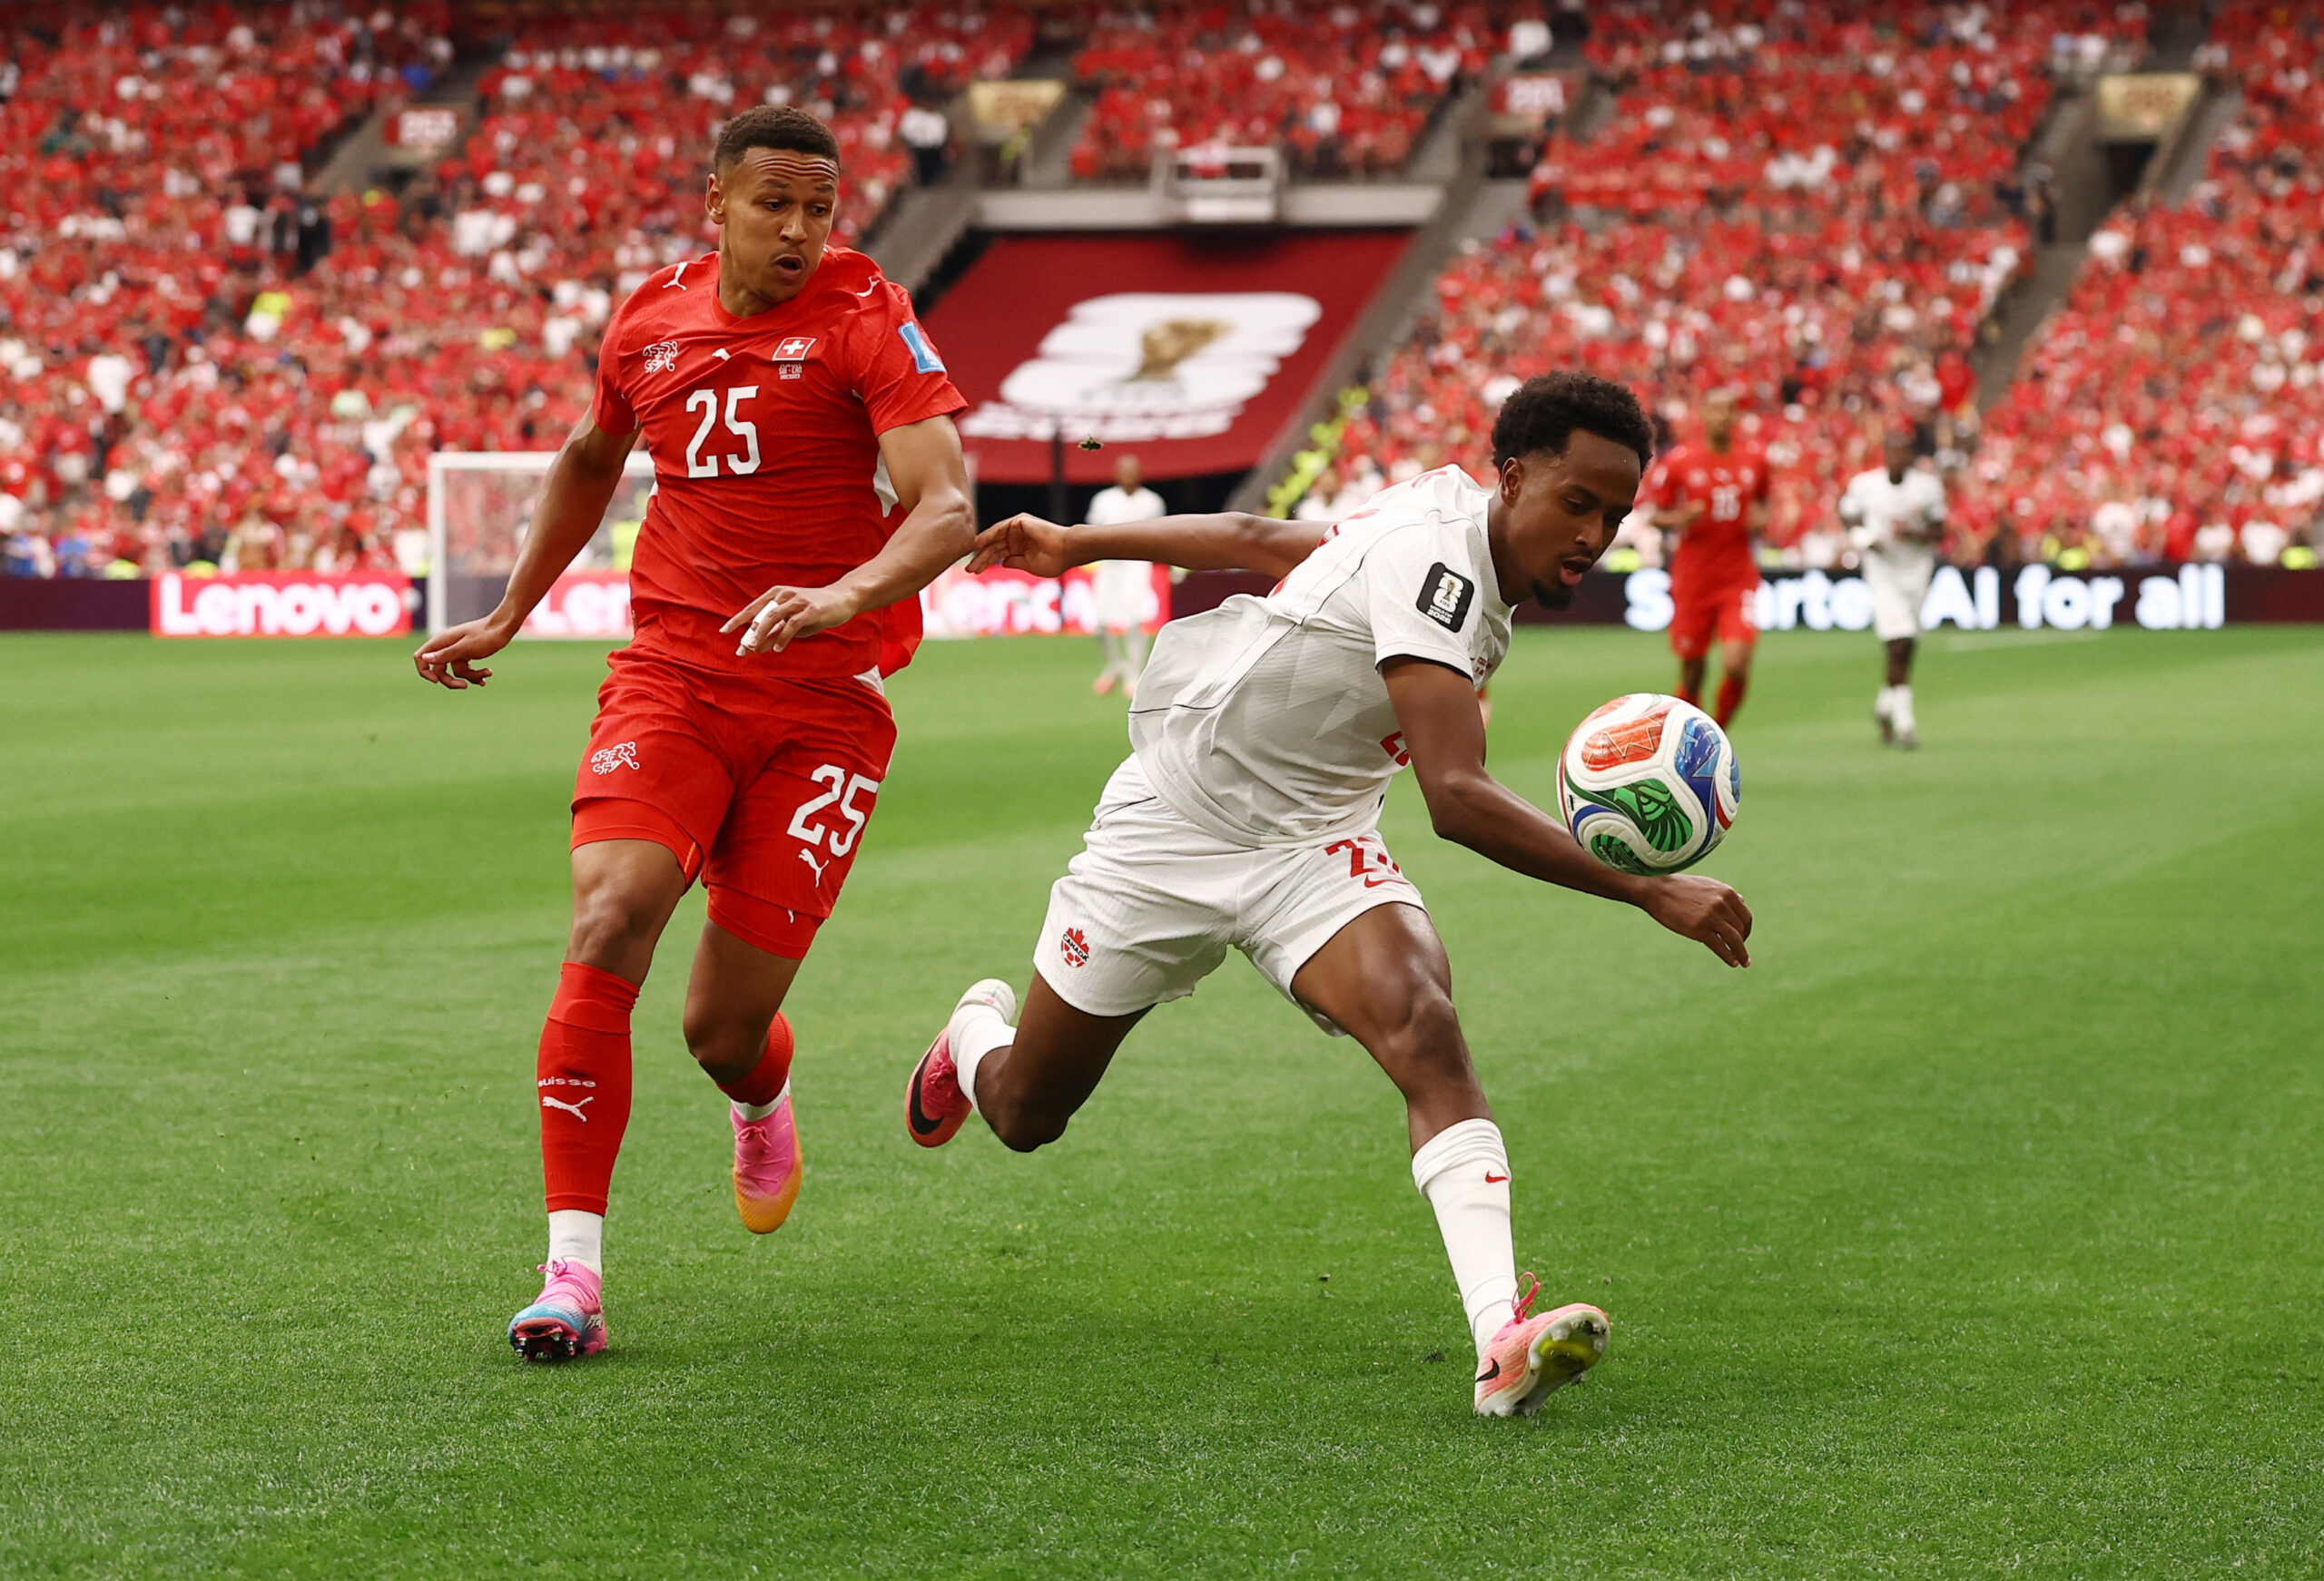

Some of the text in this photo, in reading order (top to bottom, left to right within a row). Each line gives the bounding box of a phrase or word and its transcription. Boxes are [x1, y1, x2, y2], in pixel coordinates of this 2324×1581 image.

[685, 386, 762, 478] 25
[159, 571, 400, 634] Lenovo
[1427, 609, 1452, 624] 2026
[1918, 565, 2000, 631] AI
[2012, 563, 2125, 631] for
[2134, 562, 2225, 631] all
[786, 763, 880, 858] 25
[1062, 933, 1089, 962] CANADA
[537, 1075, 596, 1088] suisse
